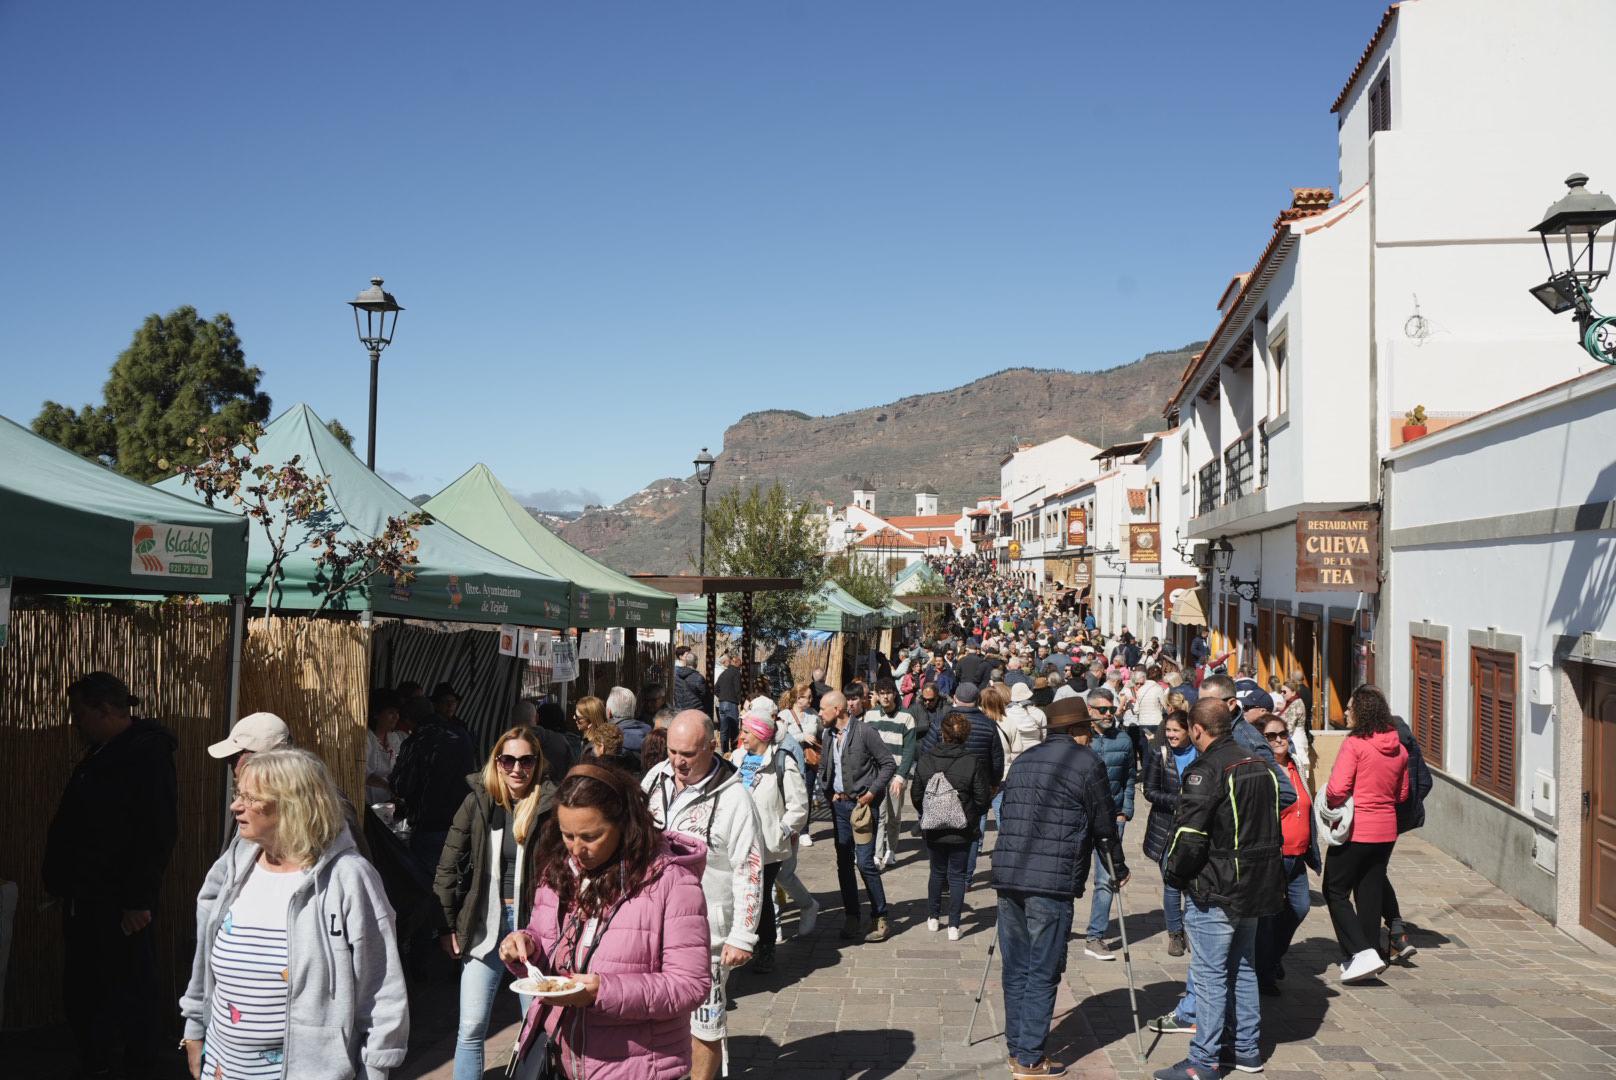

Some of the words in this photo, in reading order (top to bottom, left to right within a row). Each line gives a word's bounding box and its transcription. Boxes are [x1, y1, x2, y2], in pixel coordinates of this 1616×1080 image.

[1308, 520, 1369, 530] RESTAURANTE
[1306, 536, 1370, 554] CUEVA
[1323, 557, 1336, 566] DE
[1339, 557, 1352, 566] LA
[1320, 569, 1354, 584] TEA
[483, 583, 522, 598] Ayuntamiento
[330, 913, 342, 937] L
